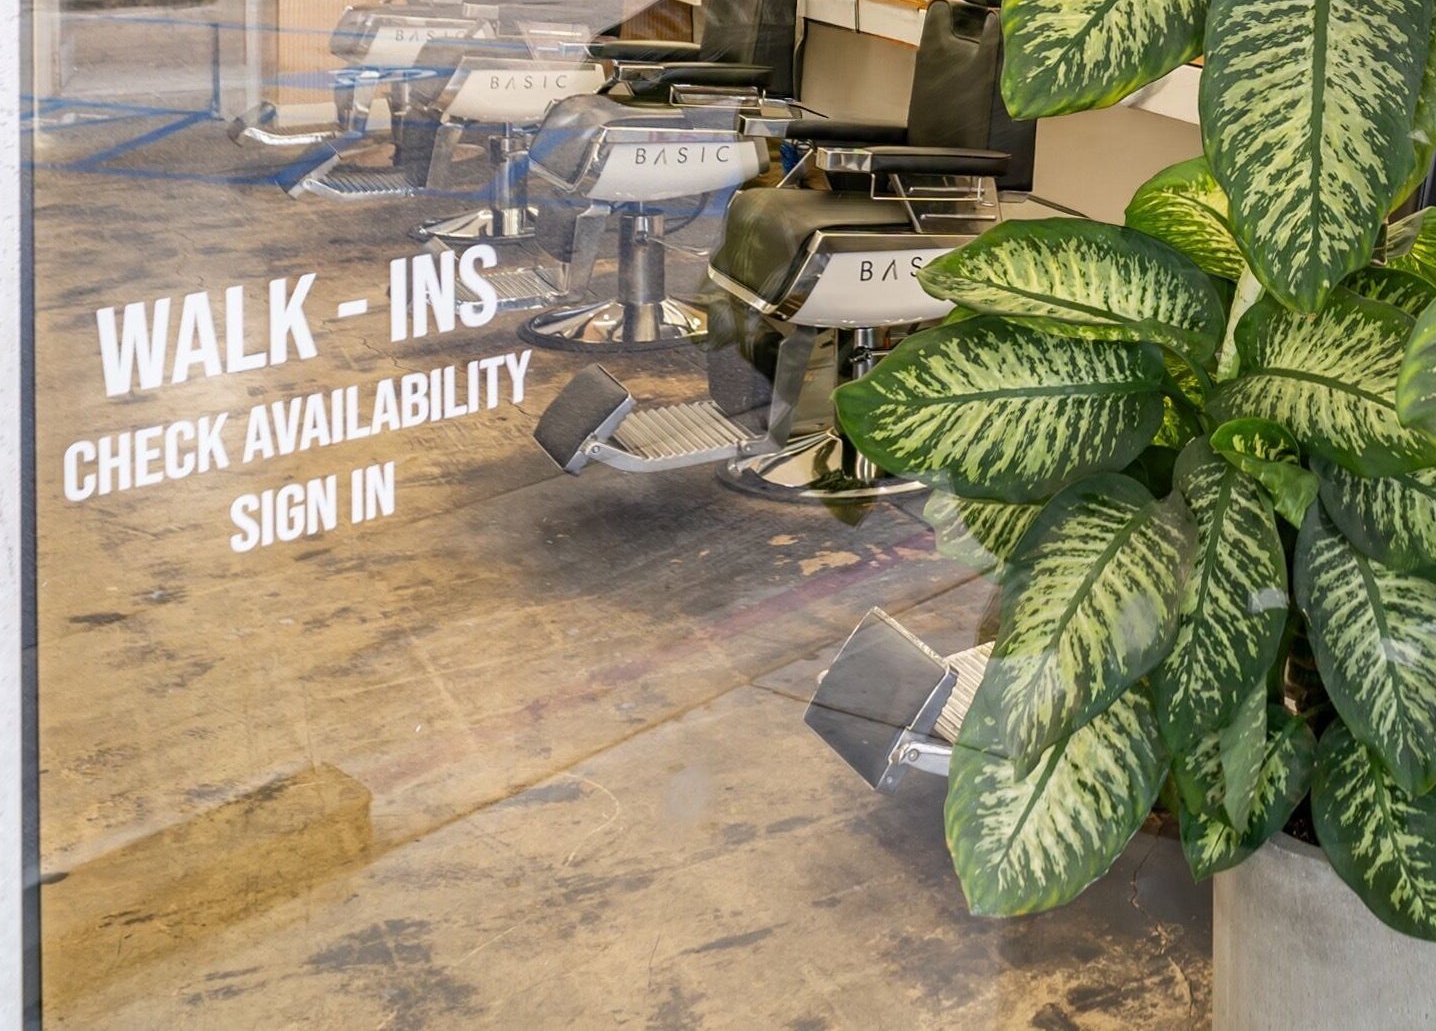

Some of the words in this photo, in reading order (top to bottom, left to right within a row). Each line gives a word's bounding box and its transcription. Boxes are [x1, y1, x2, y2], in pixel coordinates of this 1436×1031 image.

[490, 74, 567, 90] BASIC
[635, 145, 730, 165] BASIC
[95, 273, 318, 398] WALK
[390, 243, 499, 343] INS
[63, 412, 230, 502] CHECK
[242, 349, 532, 464] AVAILABILITY
[229, 474, 337, 553] SIGN
[351, 461, 395, 524] IN
